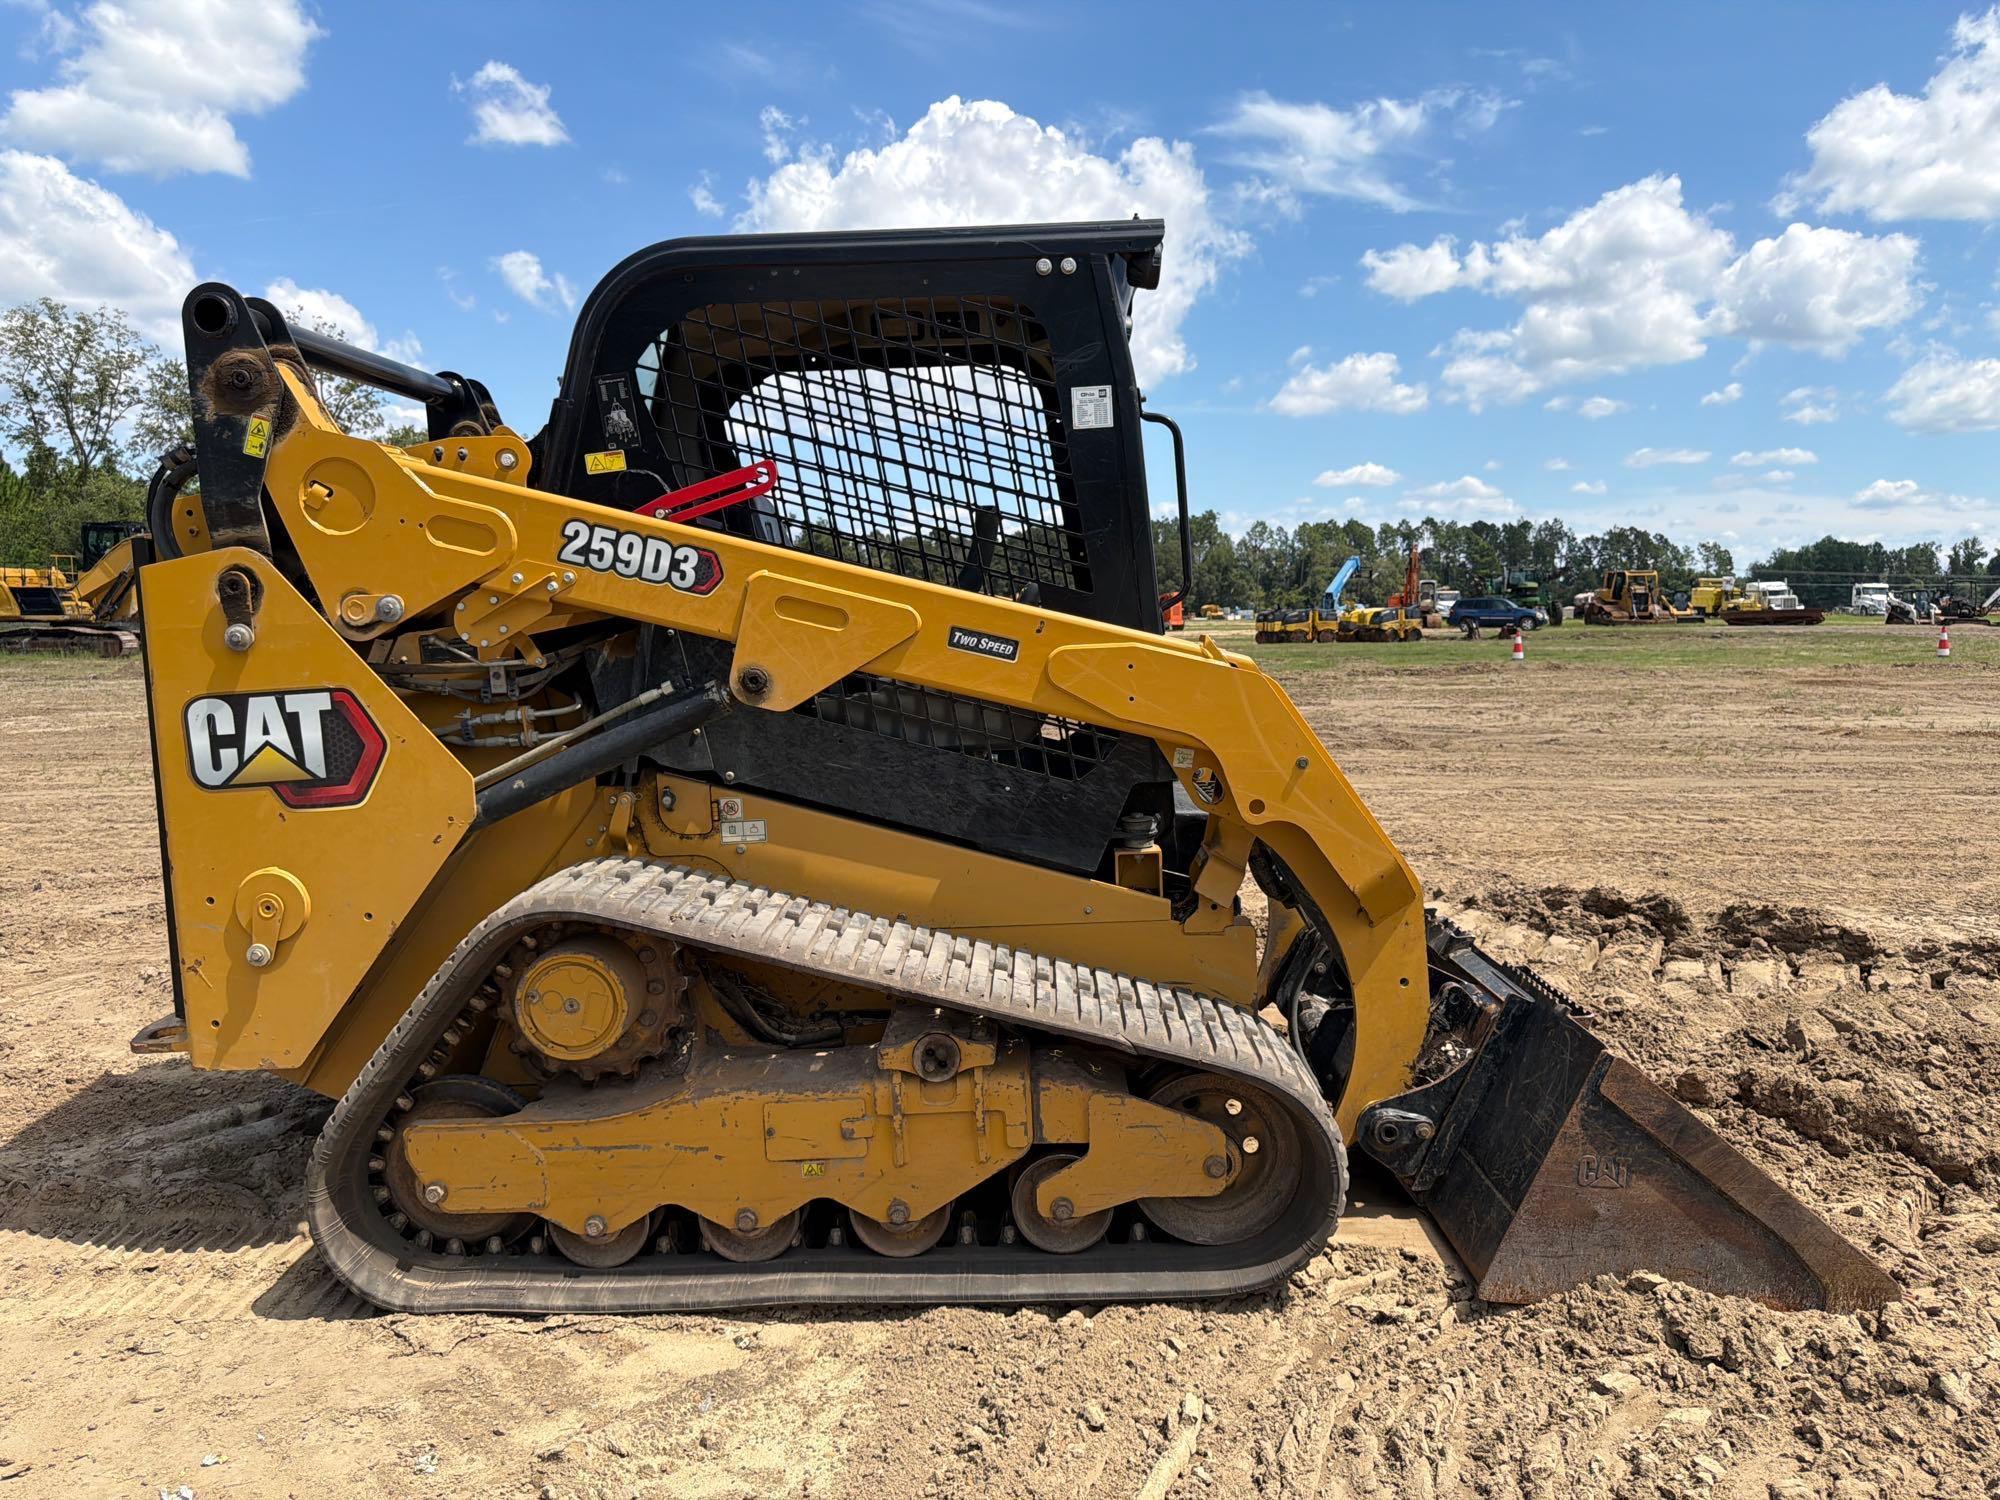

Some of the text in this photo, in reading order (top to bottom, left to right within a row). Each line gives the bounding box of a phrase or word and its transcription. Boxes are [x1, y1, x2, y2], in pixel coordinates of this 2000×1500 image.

[560, 521, 699, 588] 259D3
[953, 632, 1013, 655] TWO SPEED
[187, 692, 332, 786] CAT
[1578, 1154, 1633, 1188] CAT
